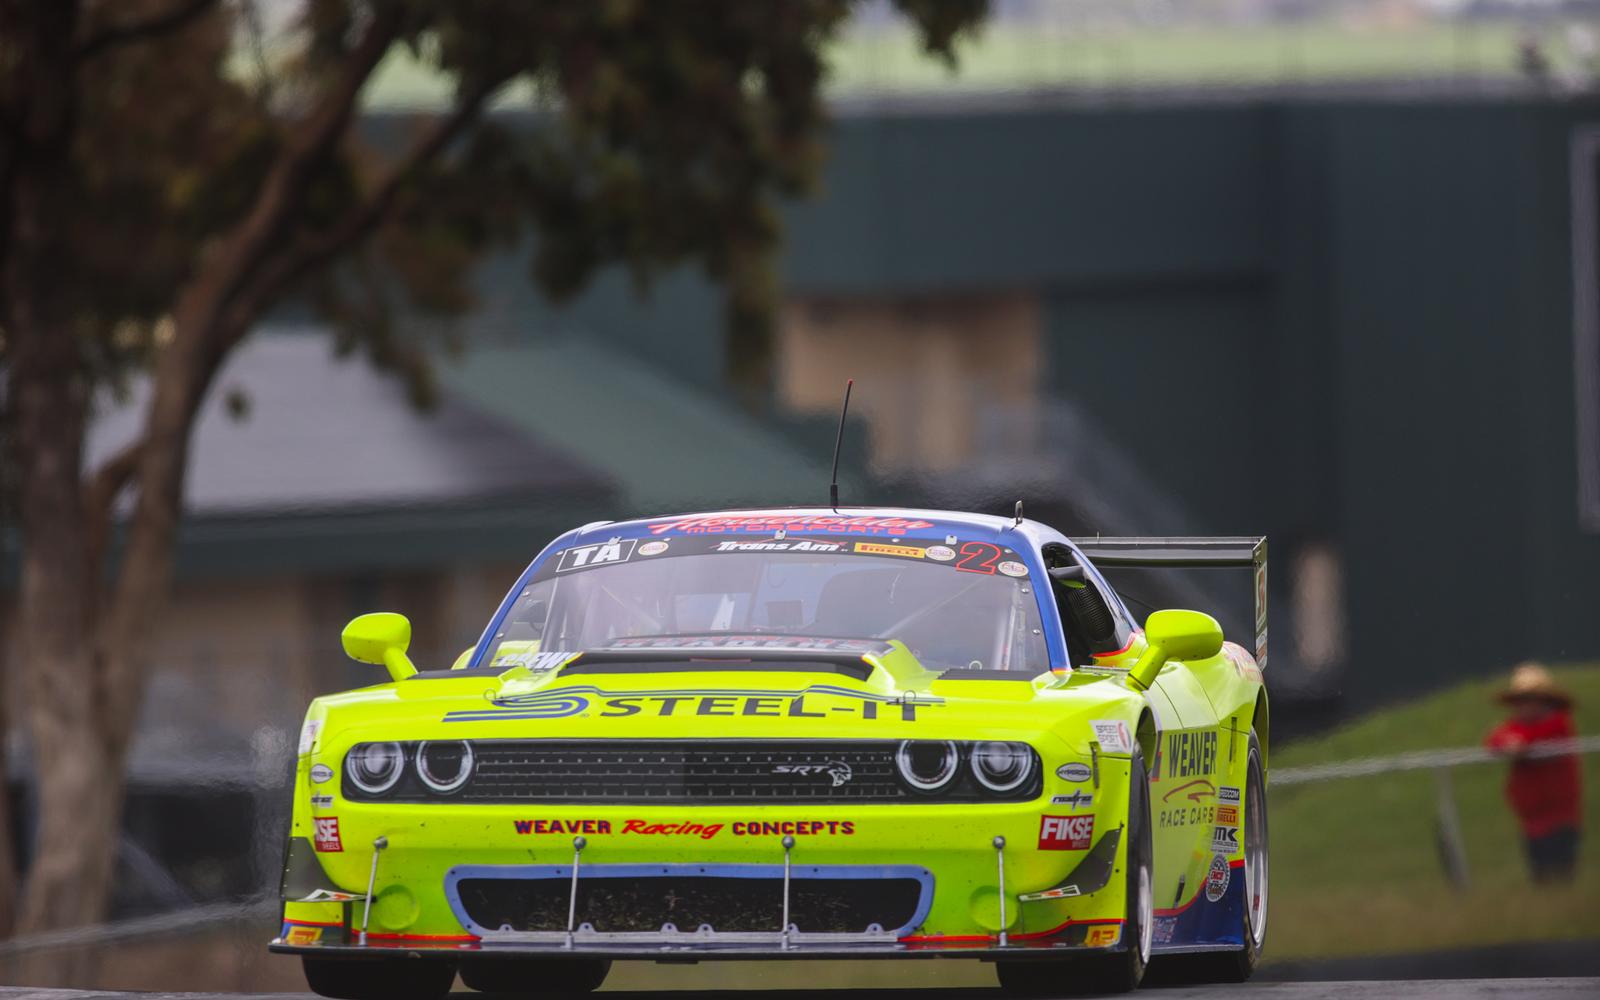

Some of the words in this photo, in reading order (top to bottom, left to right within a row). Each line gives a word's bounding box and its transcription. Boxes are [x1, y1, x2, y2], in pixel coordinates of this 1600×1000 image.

[687, 523, 907, 536] MOTORSPORTS
[573, 543, 621, 567] TA
[716, 541, 789, 551] Trans
[790, 541, 839, 551] Am
[861, 544, 920, 556] PIRELLI
[955, 541, 1001, 576] 2
[600, 696, 932, 722] STEEL-IT
[1168, 731, 1218, 778] WEAVER
[771, 765, 831, 776] SRT
[1160, 808, 1187, 828] RACE
[1190, 805, 1214, 826] CARS
[514, 819, 611, 834] WEAVER
[621, 819, 725, 840] Racing
[732, 820, 855, 835] CONCEPTS
[1041, 817, 1093, 841] FIKSE
